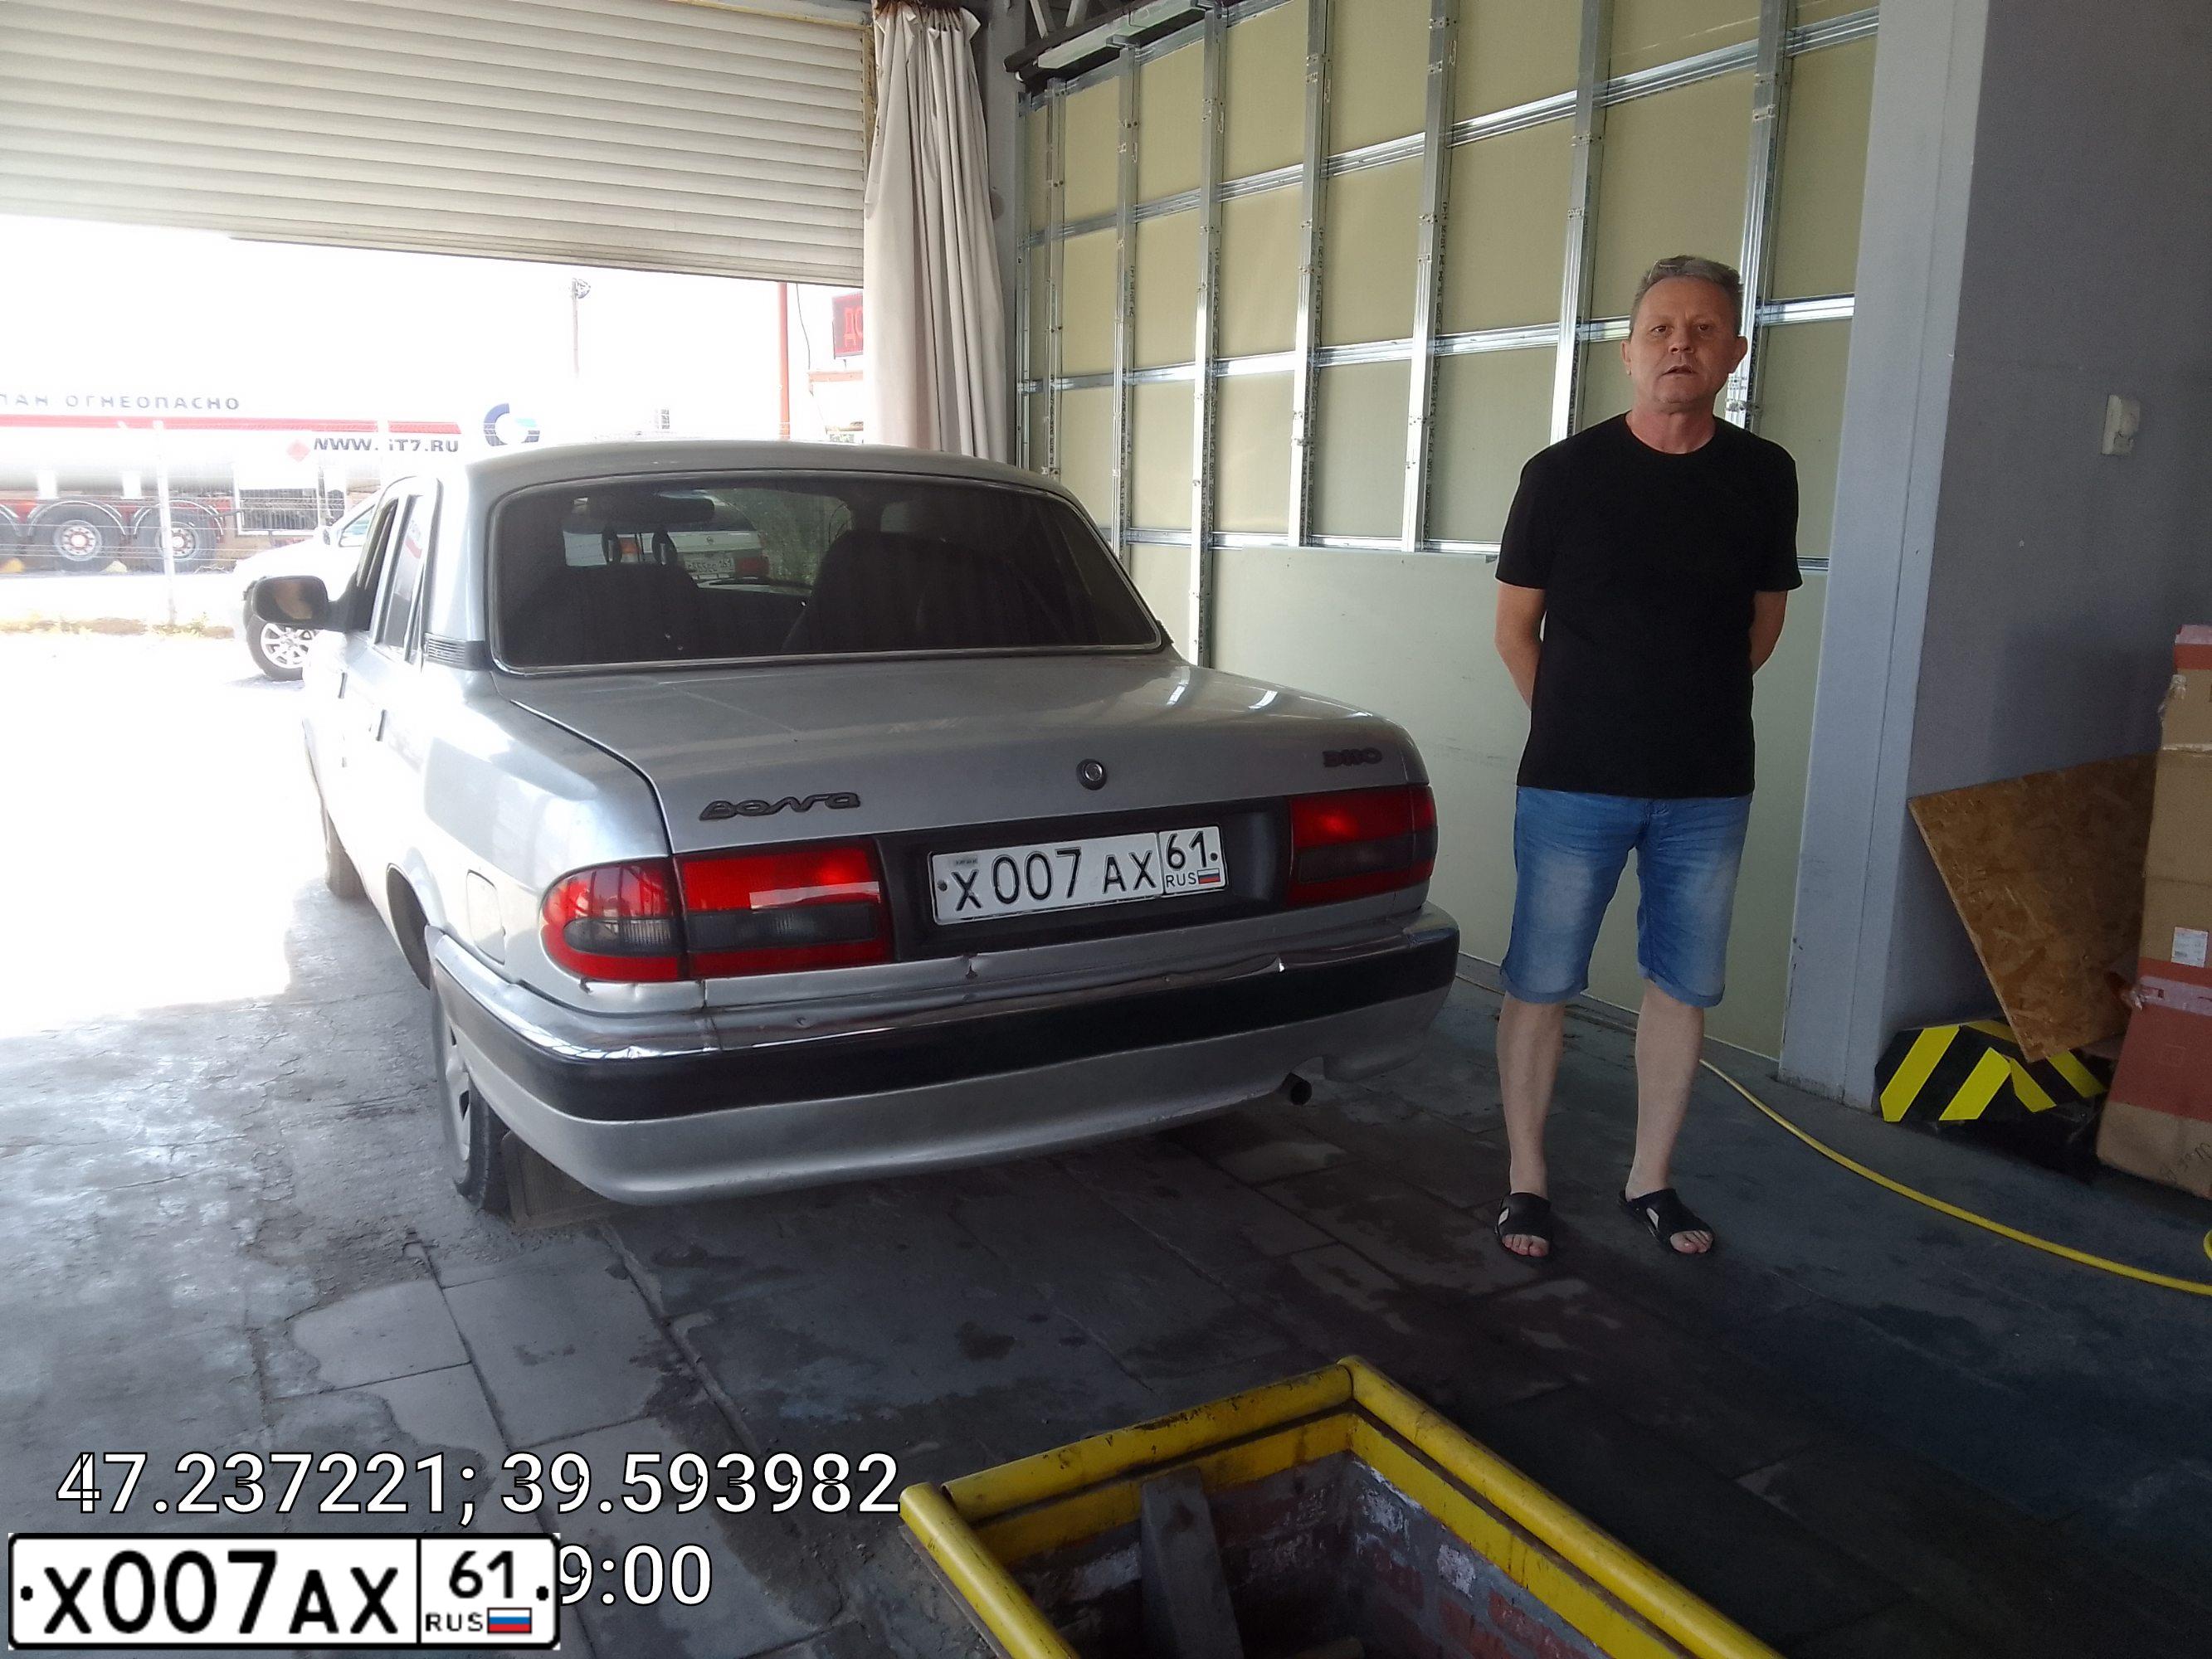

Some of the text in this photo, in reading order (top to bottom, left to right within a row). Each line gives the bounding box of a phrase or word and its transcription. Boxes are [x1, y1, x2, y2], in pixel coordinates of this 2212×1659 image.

[65, 394, 241, 411] ОГНЕОПАСНО
[1166, 830, 1207, 868] 61
[1166, 872, 1197, 888] RUS
